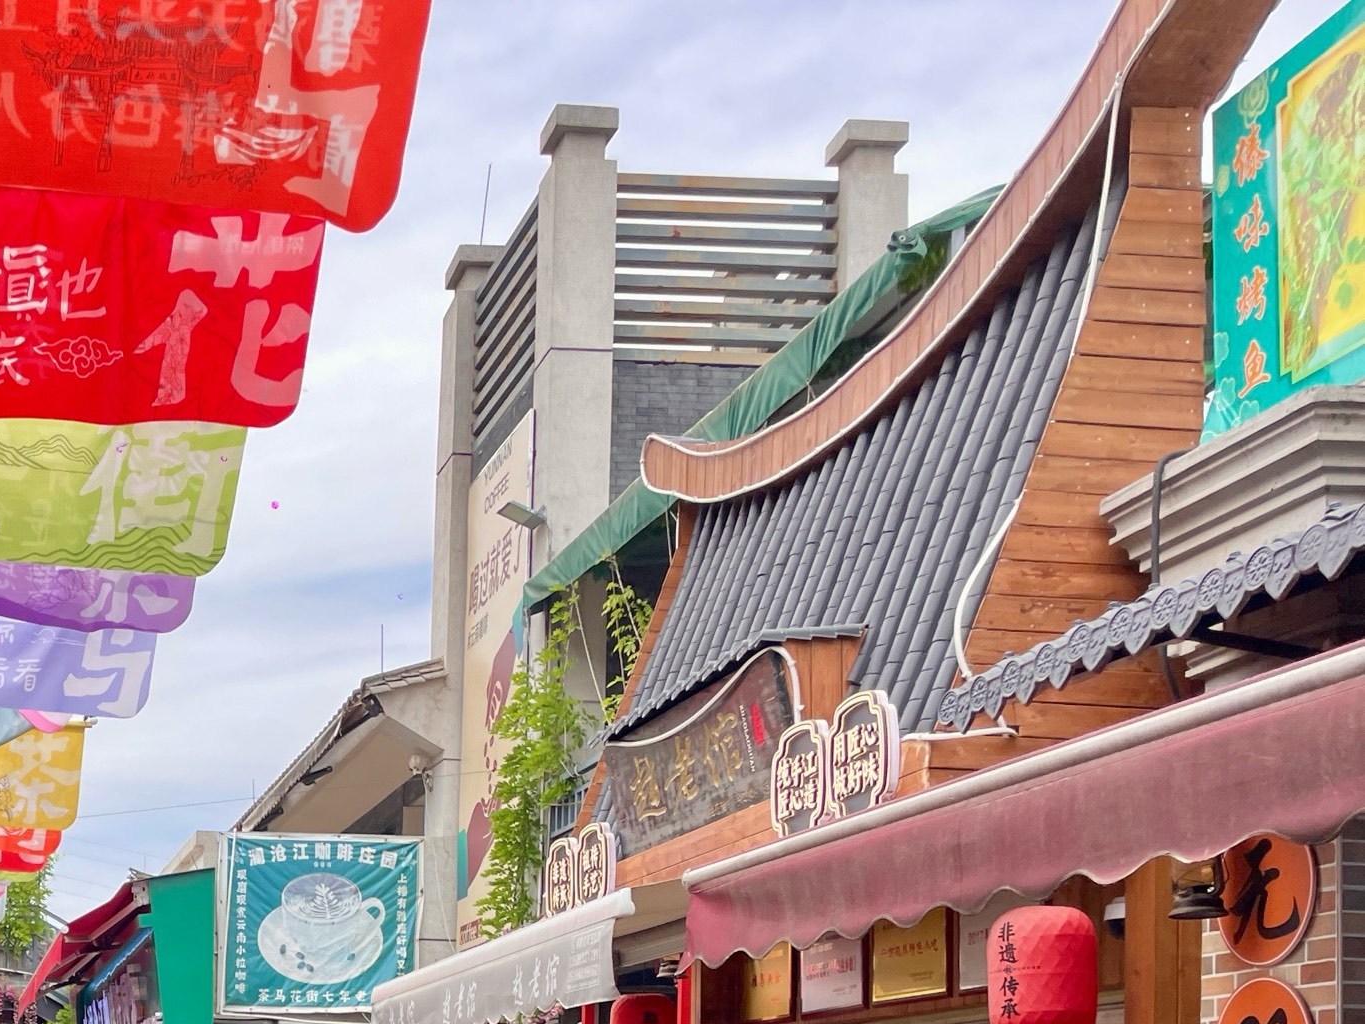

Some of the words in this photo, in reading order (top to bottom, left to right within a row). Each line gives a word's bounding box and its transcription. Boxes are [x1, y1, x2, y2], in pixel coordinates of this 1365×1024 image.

[1232, 122, 1271, 399] 傣味烤鱼
[997, 921, 1021, 1019] 非遗传承
